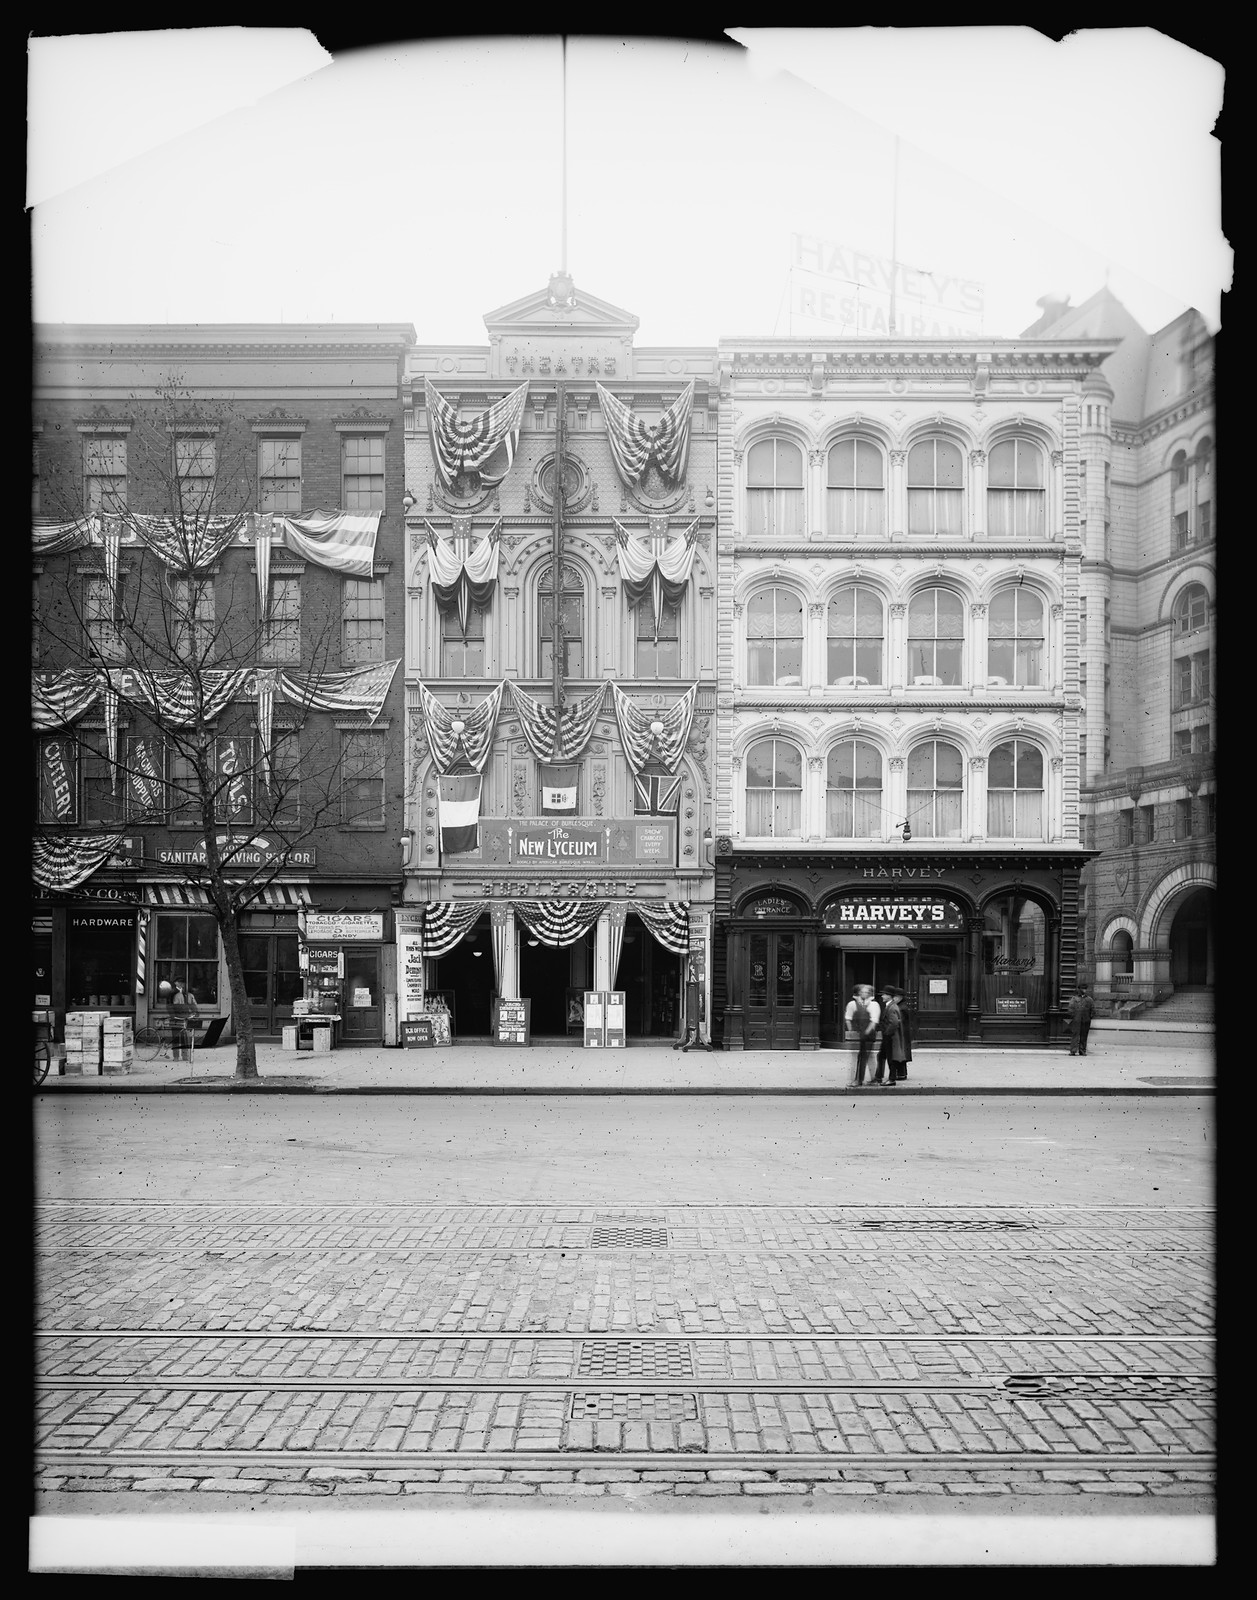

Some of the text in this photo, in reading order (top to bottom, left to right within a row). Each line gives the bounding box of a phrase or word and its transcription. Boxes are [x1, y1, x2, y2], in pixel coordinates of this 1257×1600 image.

[796, 233, 984, 312] HARVEY'S
[801, 286, 979, 336] RESTARA
[506, 355, 616, 375] THEATRE
[44, 741, 73, 819] CUTLERY
[219, 740, 248, 815] TOOLS
[130, 766, 155, 812] SUPPLIE
[547, 827, 570, 839] The
[519, 838, 597, 857] NEW LYCEUM
[160, 852, 212, 864] SANITAR
[863, 868, 946, 879] HARVEY
[482, 882, 637, 898] BURLESQUE
[840, 905, 945, 921] HARVEY'S
[73, 918, 134, 926] HARDWARE
[309, 950, 338, 958] CIGARS
